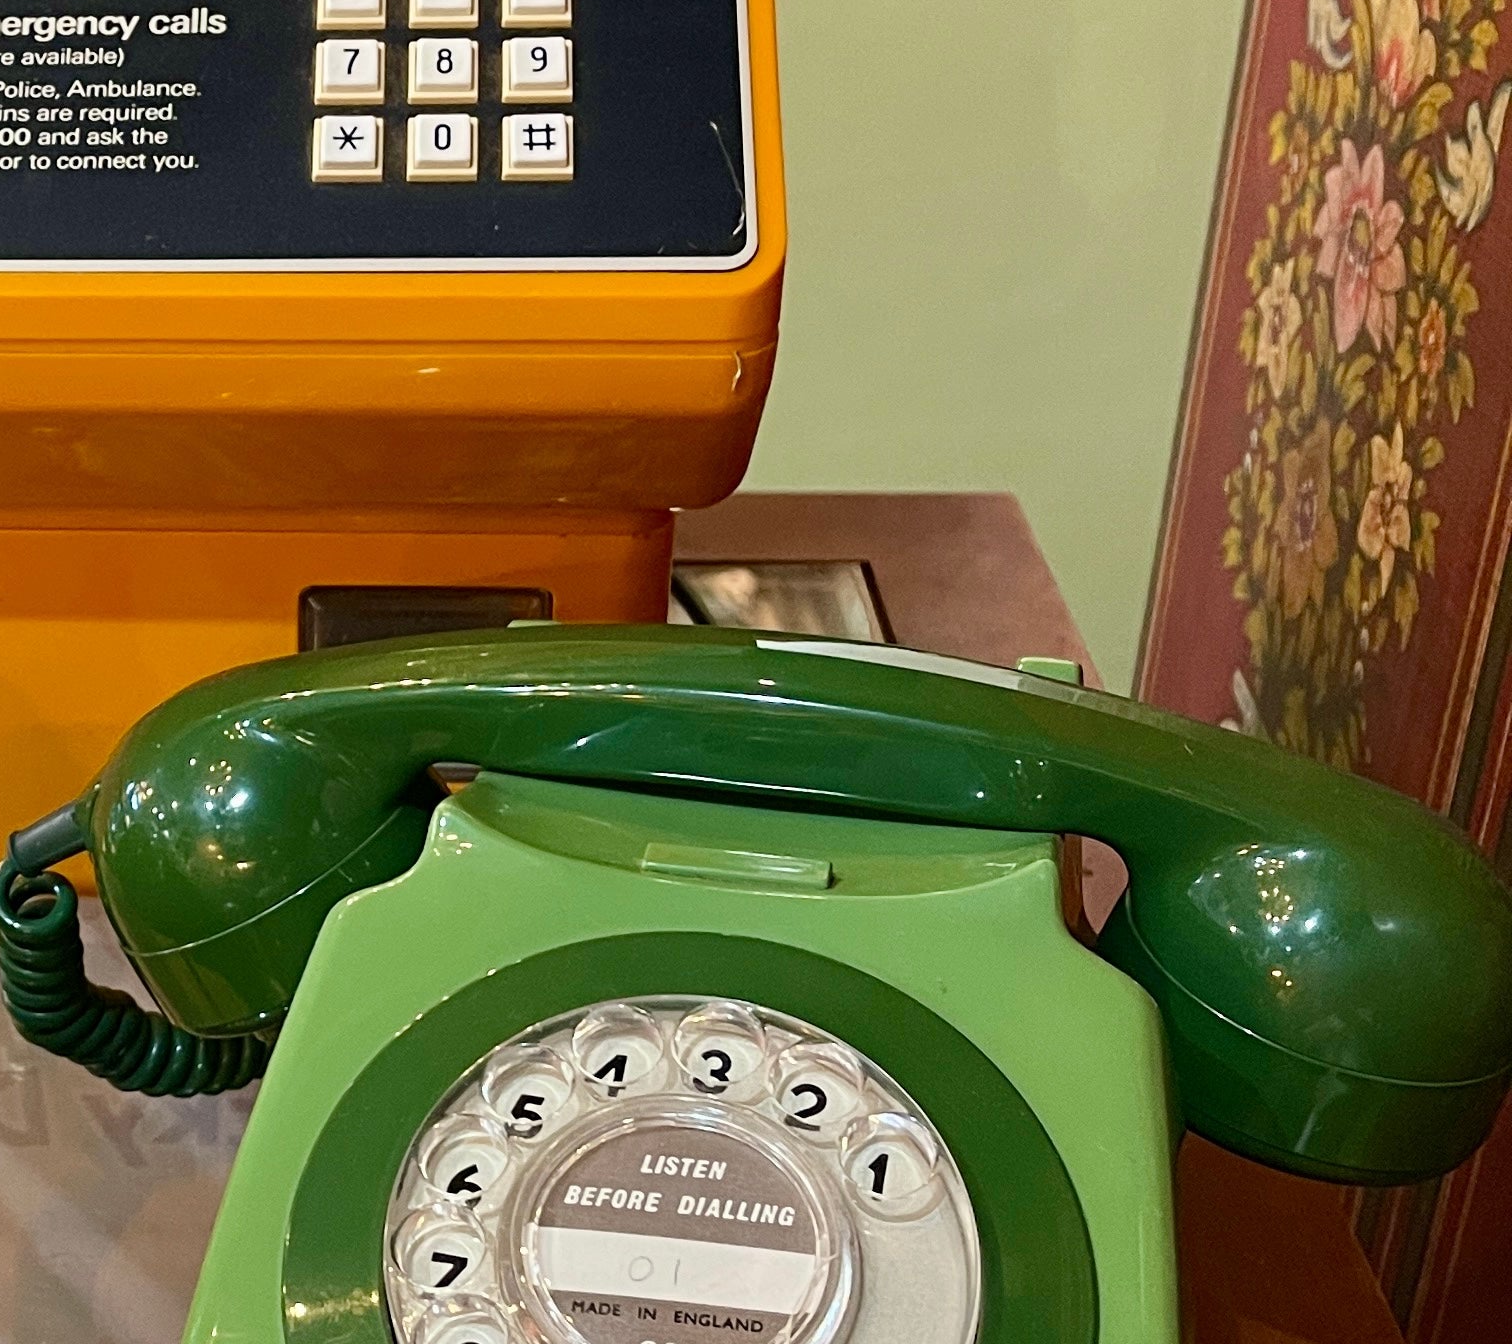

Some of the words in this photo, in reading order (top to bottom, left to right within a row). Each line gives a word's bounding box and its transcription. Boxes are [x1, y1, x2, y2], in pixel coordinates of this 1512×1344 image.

[148, 6, 228, 36] calls
[20, 46, 125, 68] available)
[342, 48, 360, 75] 7
[436, 48, 454, 74] 8
[530, 45, 548, 73] 9
[66, 79, 202, 98] Ambulance.
[35, 107, 74, 122] are
[78, 102, 178, 126] required.
[36, 127, 81, 146] and
[85, 126, 125, 146] ask
[130, 126, 169, 146] the
[433, 123, 452, 151] 0
[28, 153, 52, 171] to
[56, 153, 147, 170] connect
[152, 154, 200, 173] you.
[588, 1054, 629, 1097] 4
[693, 1049, 734, 1094] 3
[506, 1094, 546, 1139] 5
[787, 1083, 828, 1132] 2
[640, 1154, 727, 1181] LISTEN
[868, 1153, 890, 1199] 1
[563, 1185, 662, 1212] BEFORE
[677, 1195, 796, 1226] DIALLING
[430, 1251, 468, 1288] 7
[571, 1299, 622, 1318] MADE
[637, 1307, 657, 1321] IN
[674, 1310, 764, 1334] ENGLAND
